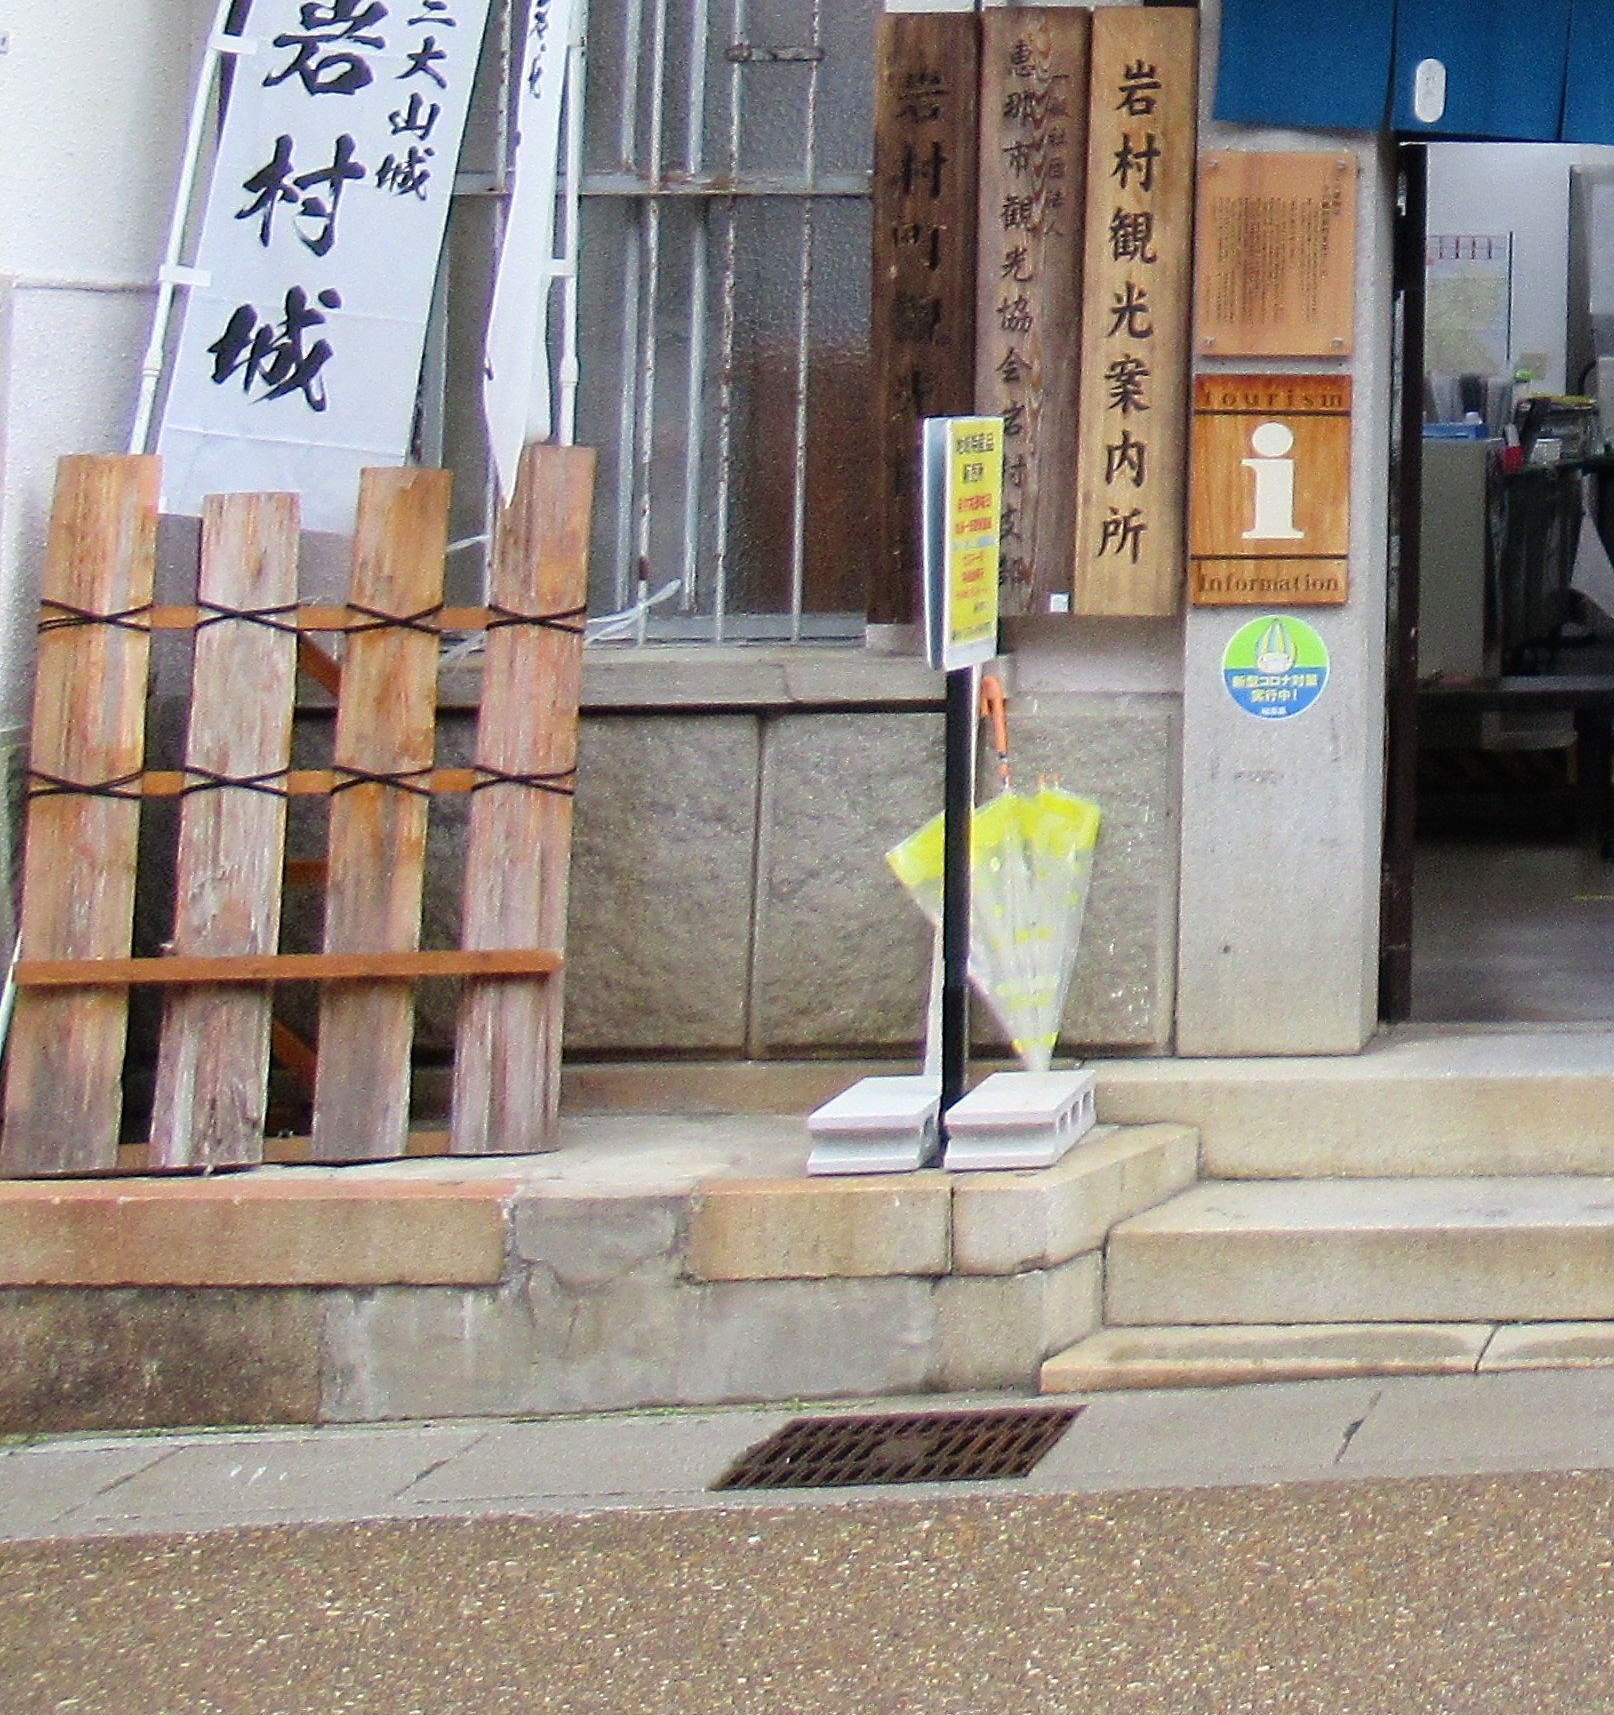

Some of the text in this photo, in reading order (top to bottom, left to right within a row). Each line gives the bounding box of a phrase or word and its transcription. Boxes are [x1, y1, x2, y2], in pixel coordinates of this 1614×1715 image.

[1094, 59, 1163, 566] 岩村観光案内所
[1202, 387, 1344, 409] tourism
[1199, 573, 1340, 594] Information
